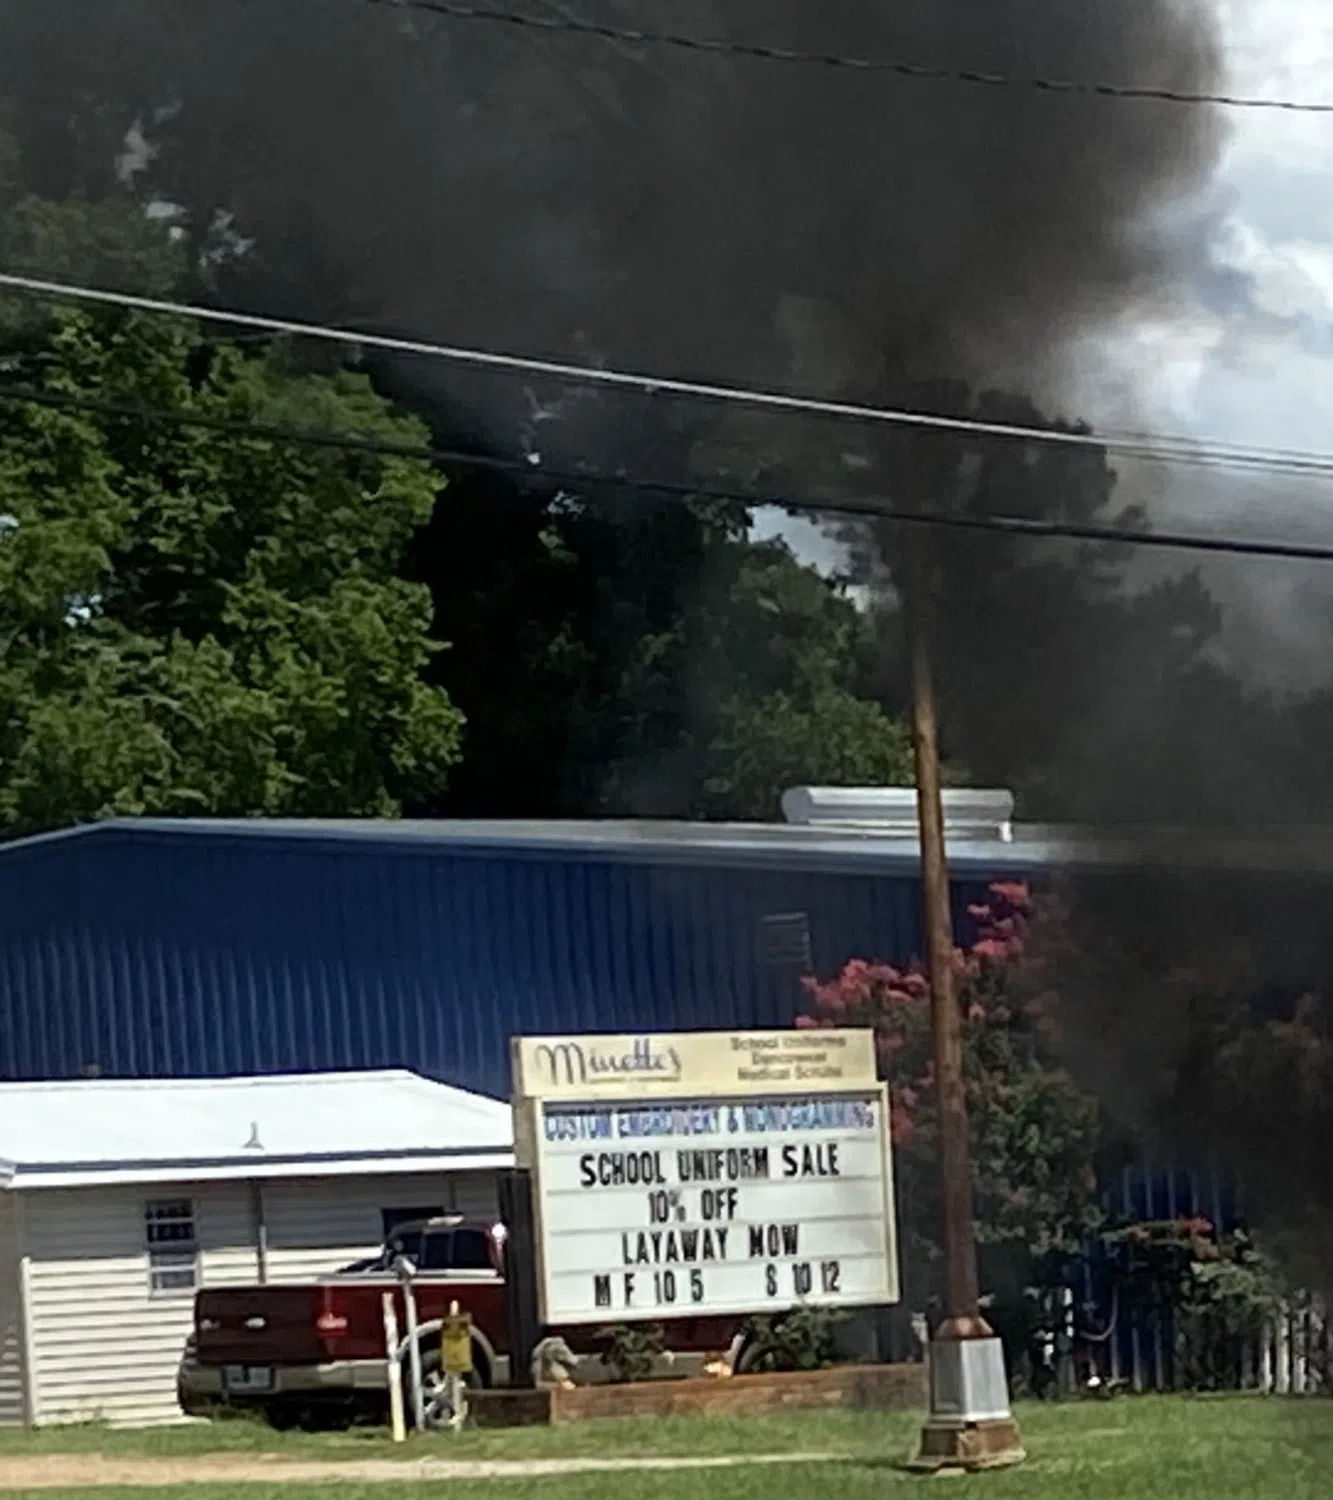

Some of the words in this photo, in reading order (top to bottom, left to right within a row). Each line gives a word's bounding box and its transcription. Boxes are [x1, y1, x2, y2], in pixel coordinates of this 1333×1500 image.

[545, 1109, 612, 1141] CUSTOM
[580, 1152, 666, 1186] SCHOOL
[676, 1146, 769, 1182] UNIFORM
[782, 1143, 840, 1177] SALE
[649, 1189, 687, 1223] 10%
[701, 1187, 739, 1220] OFF
[622, 1227, 729, 1266] LAYAWAY
[594, 1274, 611, 1307] M
[624, 1273, 636, 1305] F
[654, 1270, 676, 1304] 10
[690, 1268, 704, 1301] 5
[792, 1262, 812, 1294] 10
[821, 1260, 841, 1292] 12
